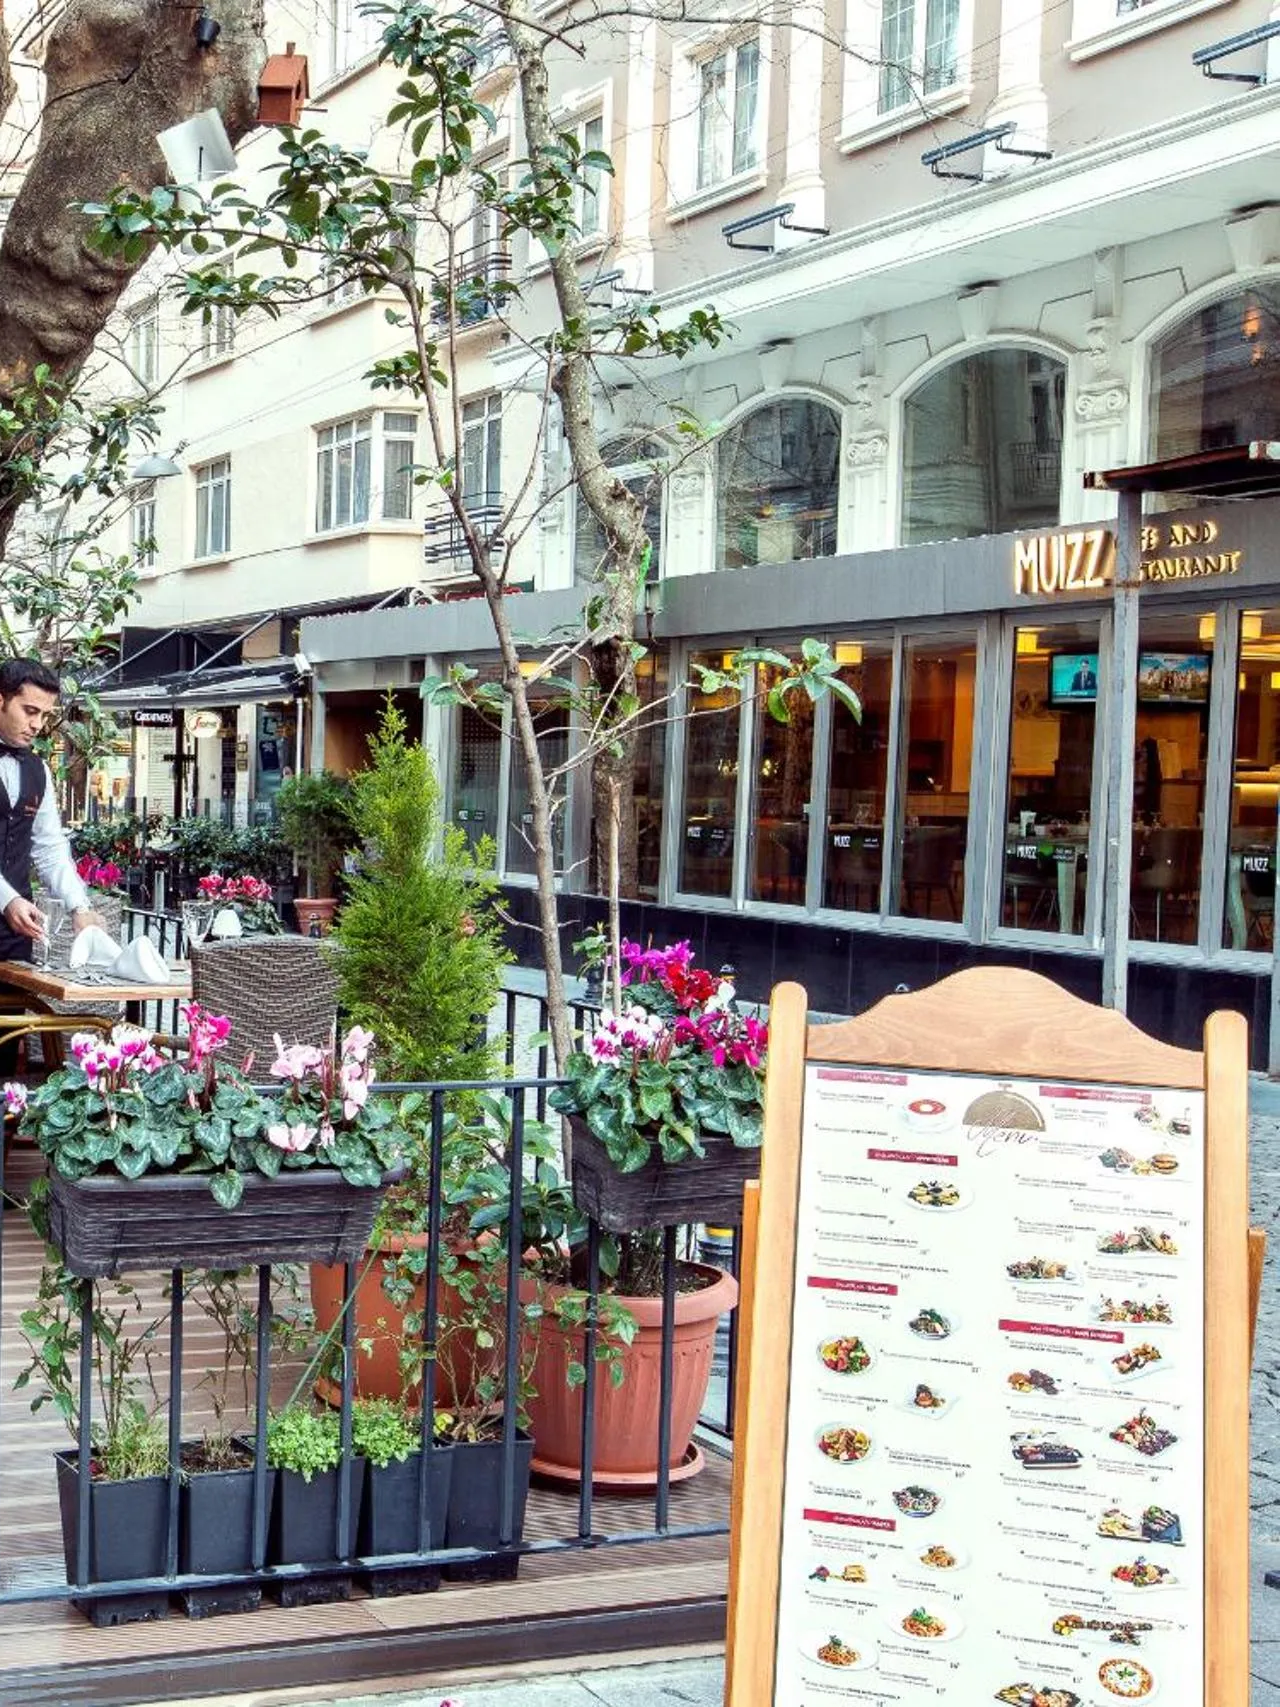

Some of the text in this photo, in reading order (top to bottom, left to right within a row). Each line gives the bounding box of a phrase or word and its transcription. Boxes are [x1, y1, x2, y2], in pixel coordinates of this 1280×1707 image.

[1169, 521, 1218, 547] AND
[1014, 530, 1108, 595] MUIZZ
[1140, 551, 1241, 580] TAURANT
